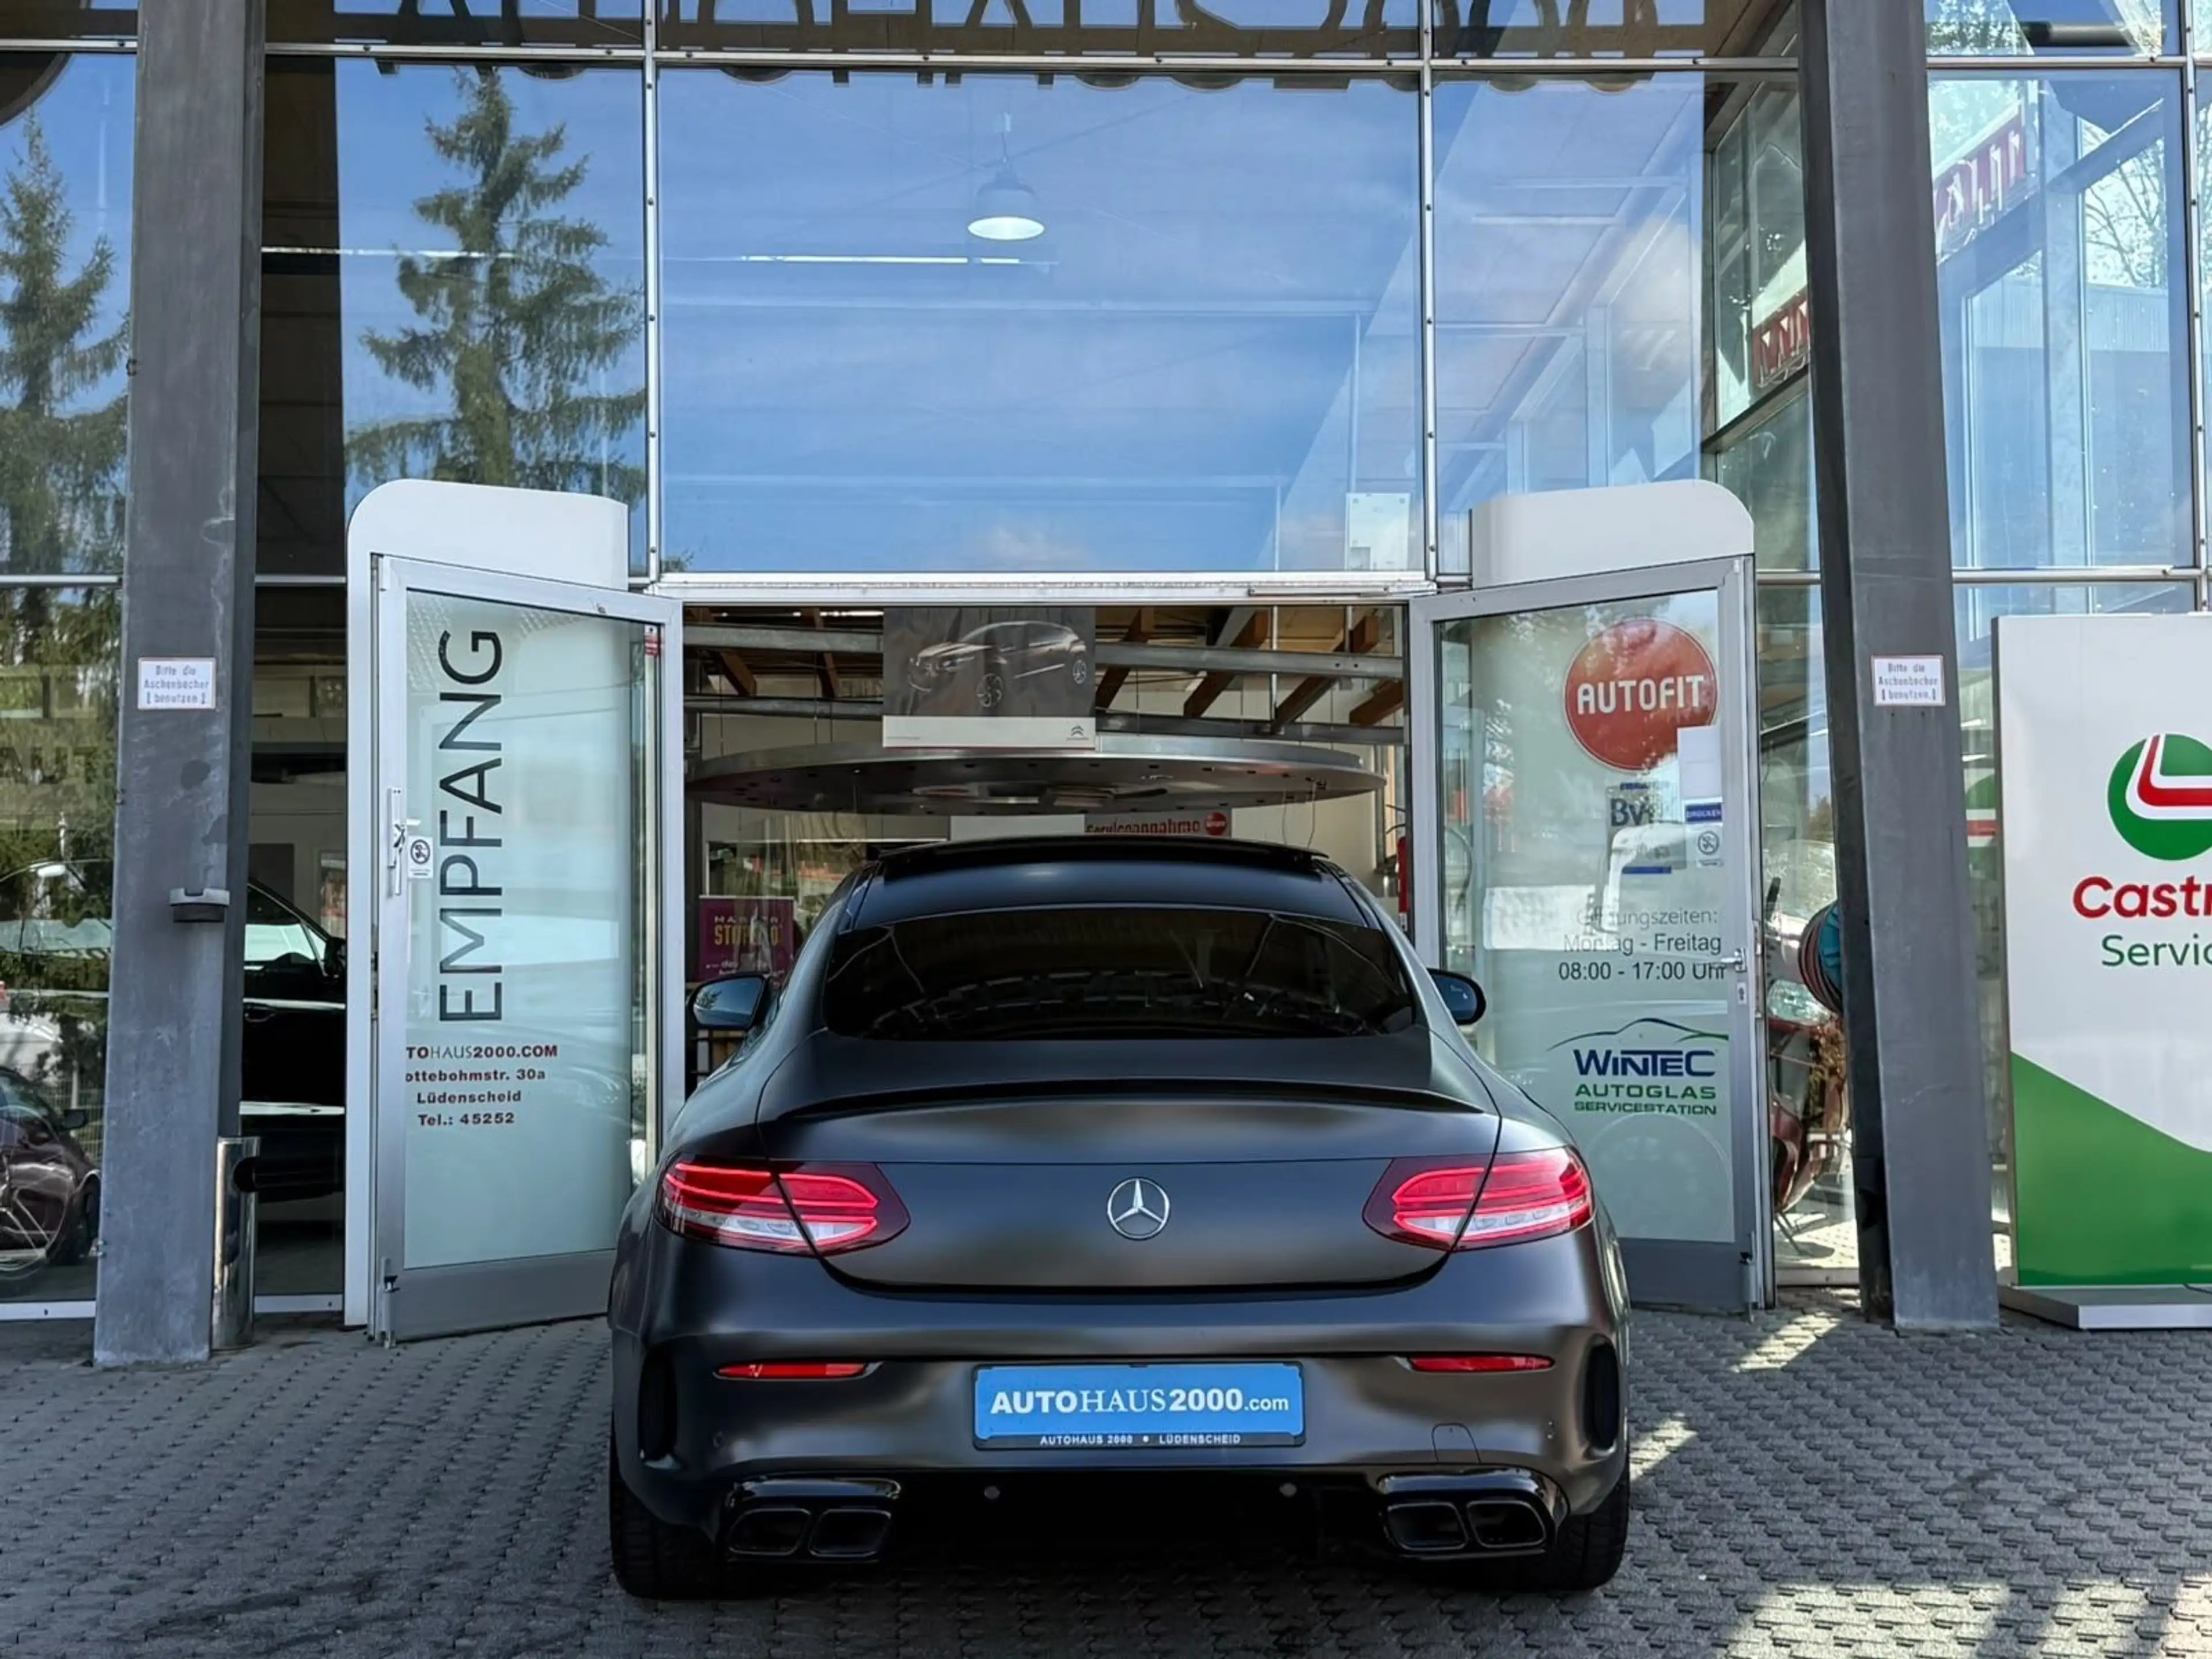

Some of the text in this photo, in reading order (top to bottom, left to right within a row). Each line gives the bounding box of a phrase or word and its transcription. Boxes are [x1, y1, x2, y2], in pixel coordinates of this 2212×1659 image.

[1888, 663, 1907, 673] Bitte
[1577, 675, 1705, 715] AUTOFIT
[439, 630, 502, 1021] EMPFANG
[1564, 934, 1634, 956] Monag
[1654, 933, 1721, 955] Freitag
[1558, 961, 1612, 980] 08:00
[1632, 961, 1685, 980] 17:00
[1692, 962, 1726, 980] Uhr
[405, 1068, 546, 1082] ottebohmstr. 30a
[416, 1090, 522, 1104] Lüdenscheid
[1575, 1083, 1717, 1100] AUTOGLAS
[1574, 1101, 1717, 1115] SERVICESTATION
[418, 1112, 515, 1126] Tel.: 45252
[990, 1388, 1290, 1414] AUTOHAUS2000.com
[1040, 1434, 1103, 1445] AUTOHAUS
